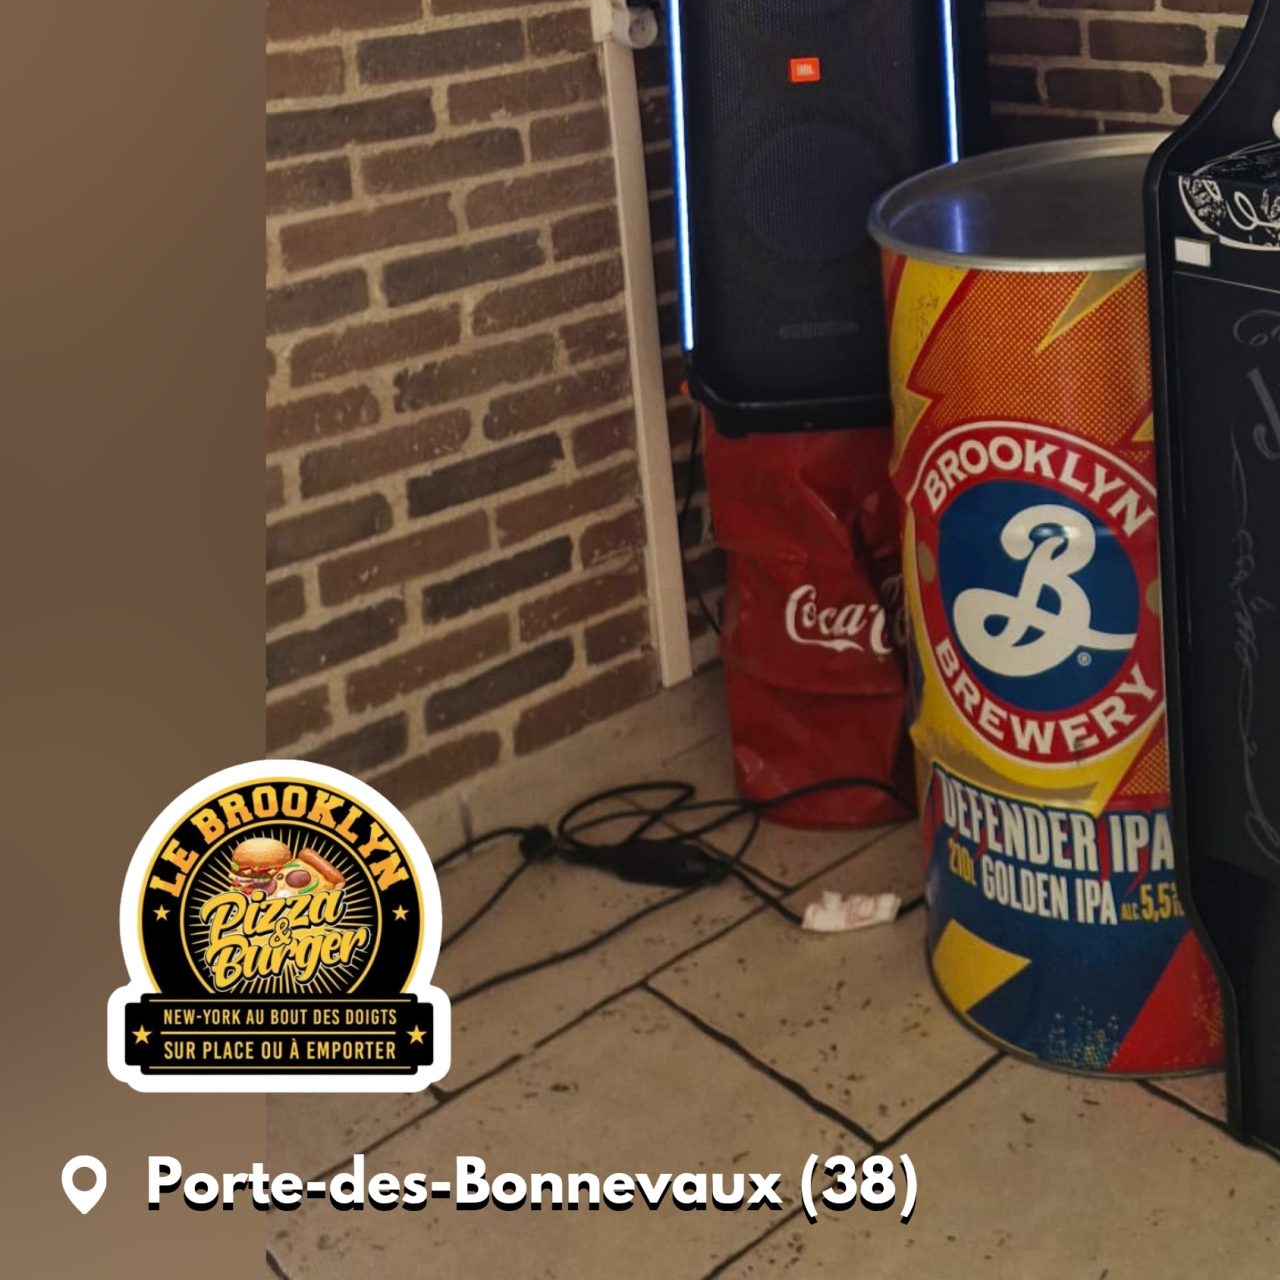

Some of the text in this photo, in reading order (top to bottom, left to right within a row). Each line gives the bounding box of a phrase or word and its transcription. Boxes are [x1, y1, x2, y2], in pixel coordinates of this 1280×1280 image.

[923, 436, 1156, 538] BROOKLYN
[936, 638, 1157, 755] BREWERY
[936, 770, 1175, 873] DEFENDER IPA
[980, 853, 1119, 926] GOLDEN IPA
